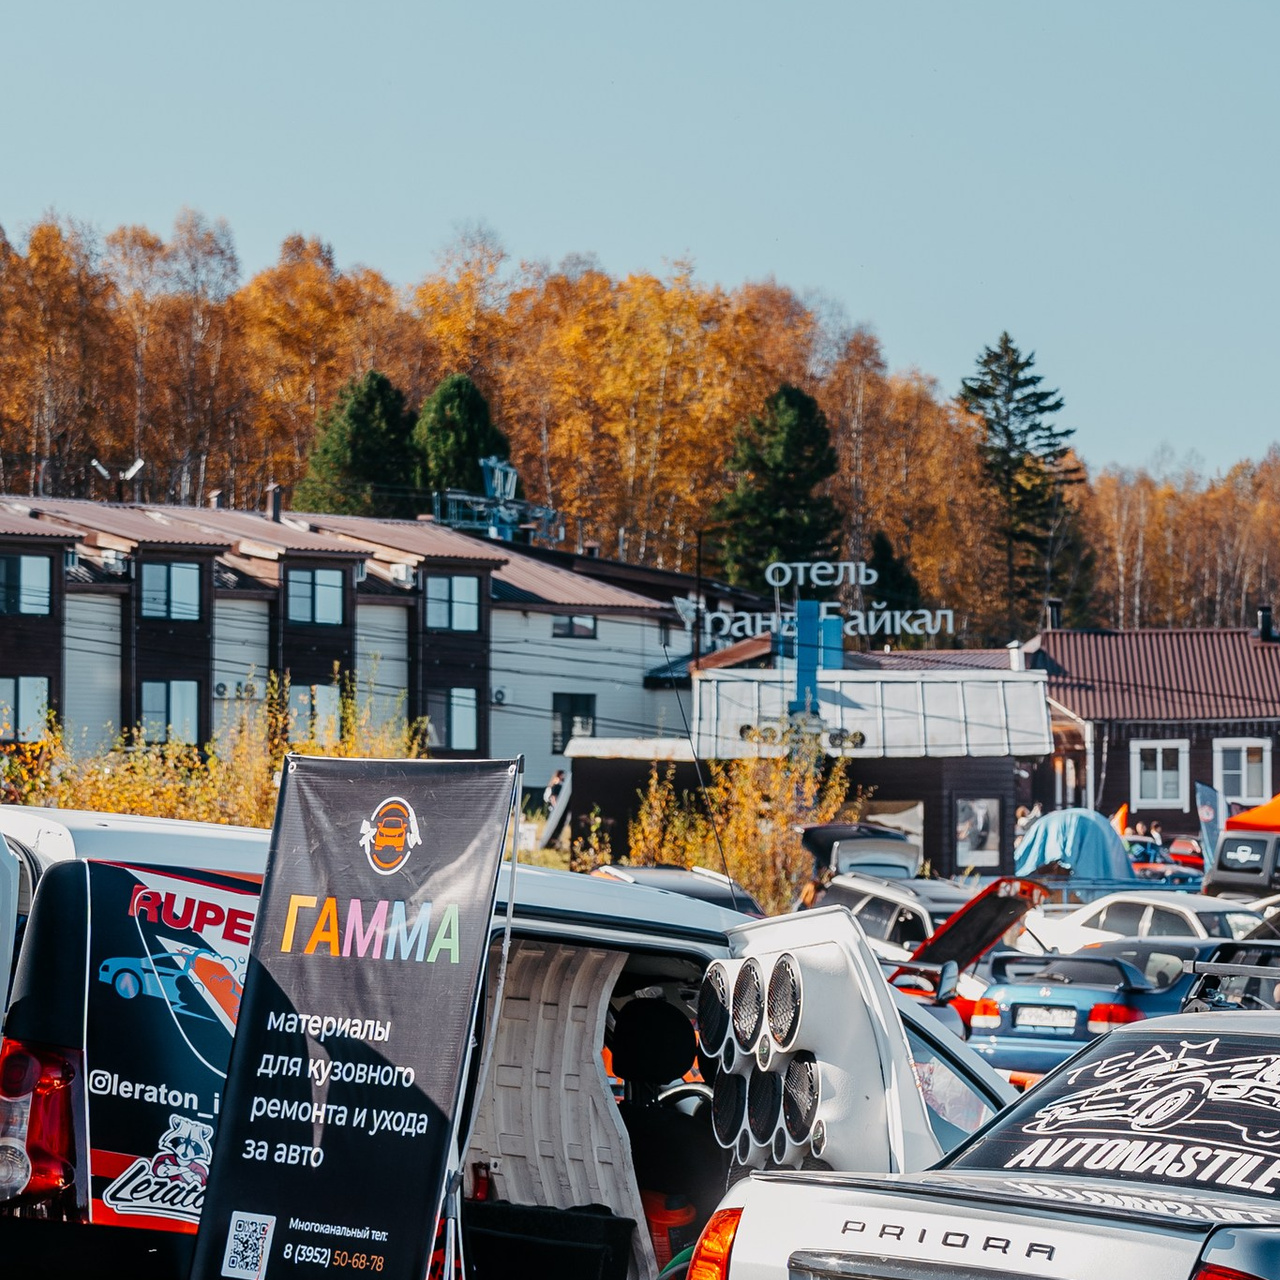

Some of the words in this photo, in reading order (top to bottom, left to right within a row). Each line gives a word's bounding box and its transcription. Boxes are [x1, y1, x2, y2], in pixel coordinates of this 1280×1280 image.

[764, 560, 880, 587] отель
[697, 610, 798, 643] ранд
[280, 894, 459, 963] ГАММА
[267, 1011, 392, 1042] материалы
[256, 1053, 302, 1078] для
[307, 1058, 416, 1087] кузовного
[1067, 1038, 1220, 1085] TEAM
[250, 1096, 348, 1126] ремонта
[352, 1107, 367, 1128] и
[368, 1108, 428, 1137] ухода
[242, 1139, 268, 1161] за
[274, 1142, 324, 1168] авто
[289, 1217, 370, 1240] Многоканальный
[371, 1228, 389, 1242] тел:
[841, 1220, 1056, 1261] PRIORA
[283, 1243, 293, 1259] 8
[294, 1244, 331, 1268] (3952)
[332, 1250, 385, 1272] 50-68-78
